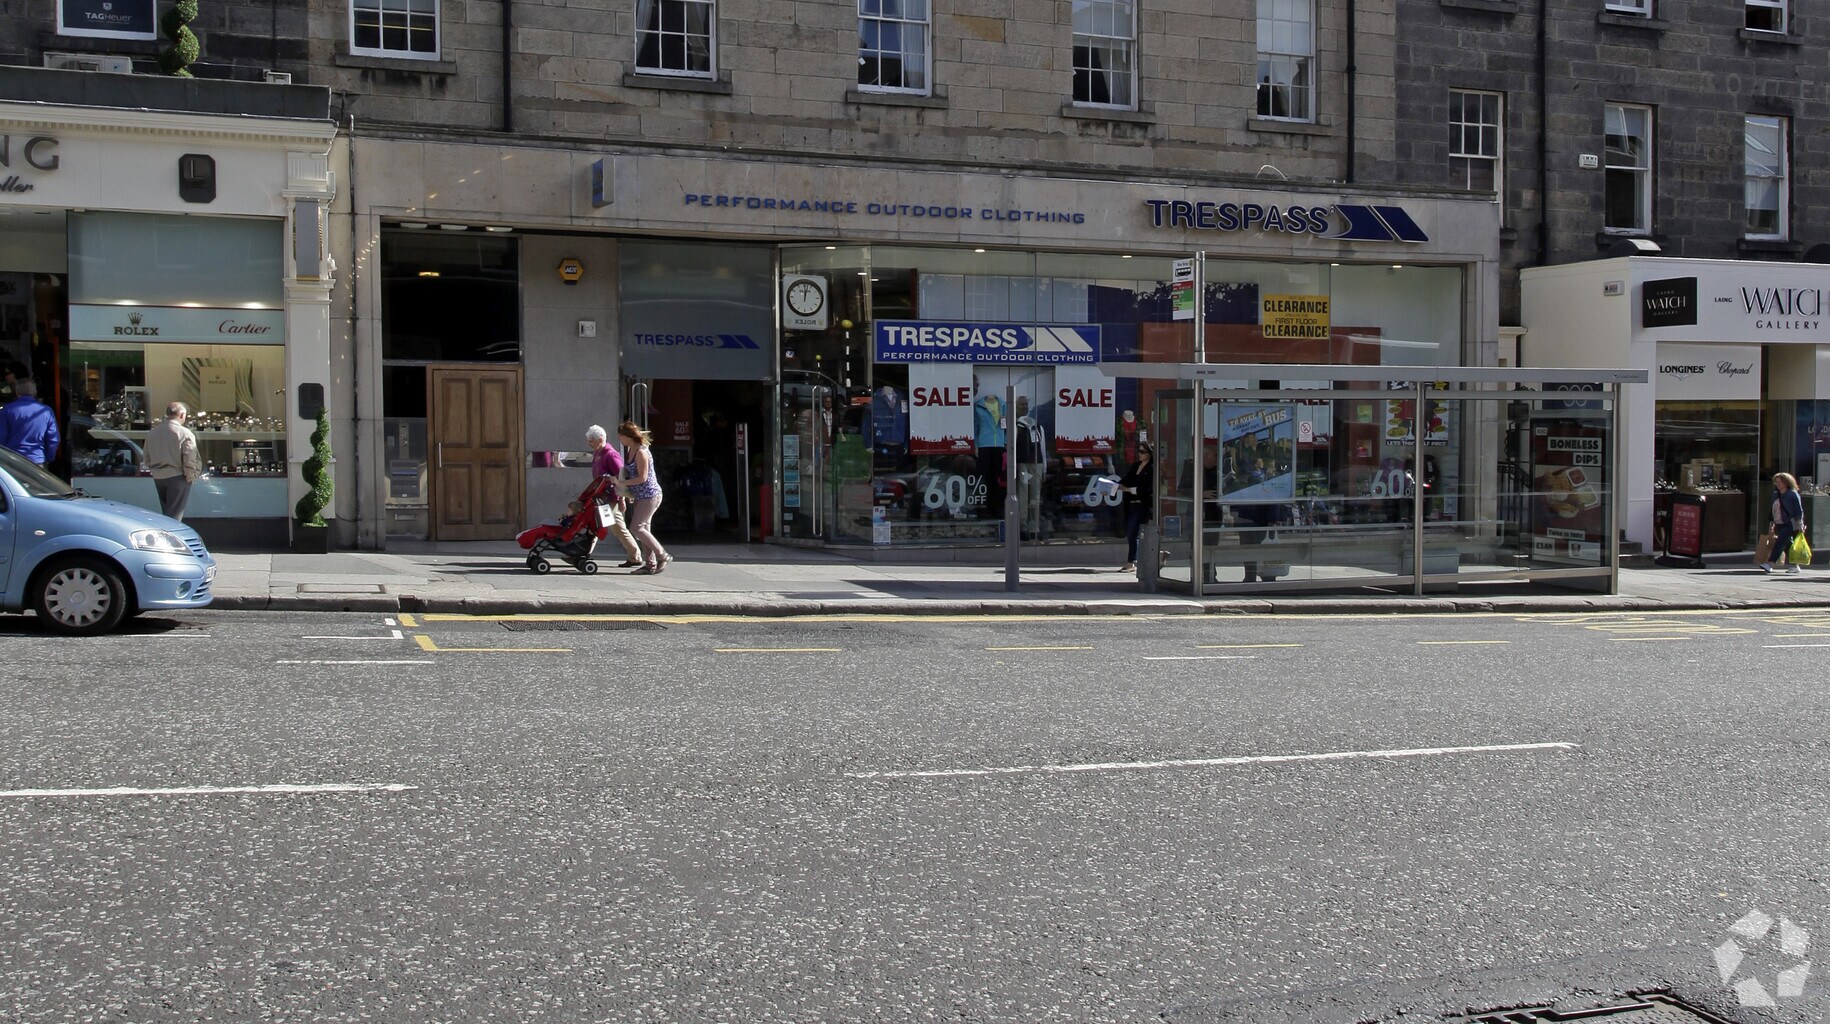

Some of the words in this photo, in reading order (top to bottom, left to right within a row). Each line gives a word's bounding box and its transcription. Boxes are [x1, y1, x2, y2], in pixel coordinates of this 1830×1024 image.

[0, 175, 34, 193] ller
[685, 193, 858, 214] PERFORMANCE
[867, 203, 973, 219] OUTDOOR
[981, 209, 1085, 224] CLOTHING
[1146, 199, 1330, 234] TRESPASS
[1264, 300, 1328, 314] CLEARANCE
[1646, 296, 1687, 310] WATCH
[113, 326, 160, 336] ROLEX
[218, 319, 271, 334] Cartier
[1264, 324, 1328, 338] CLEARANCE
[1756, 320, 1819, 329] GALLERY
[634, 333, 714, 347] TRESPASS
[883, 326, 1019, 348] TRESPASS
[883, 351, 973, 361] PERFORMANCE
[976, 352, 1033, 361] OUTDOOR
[1037, 353, 1094, 362] CLOTHING
[1660, 365, 1705, 374] LONGINES
[1717, 360, 1754, 378] Chopard
[913, 387, 970, 407] SALE
[1058, 388, 1113, 408] SALE
[1229, 414, 1256, 427] TRAVEL
[1264, 408, 1287, 426] BUS
[1550, 439, 1599, 450] BONELESS
[1575, 454, 1599, 464] DIPS
[967, 495, 987, 505] OFF
